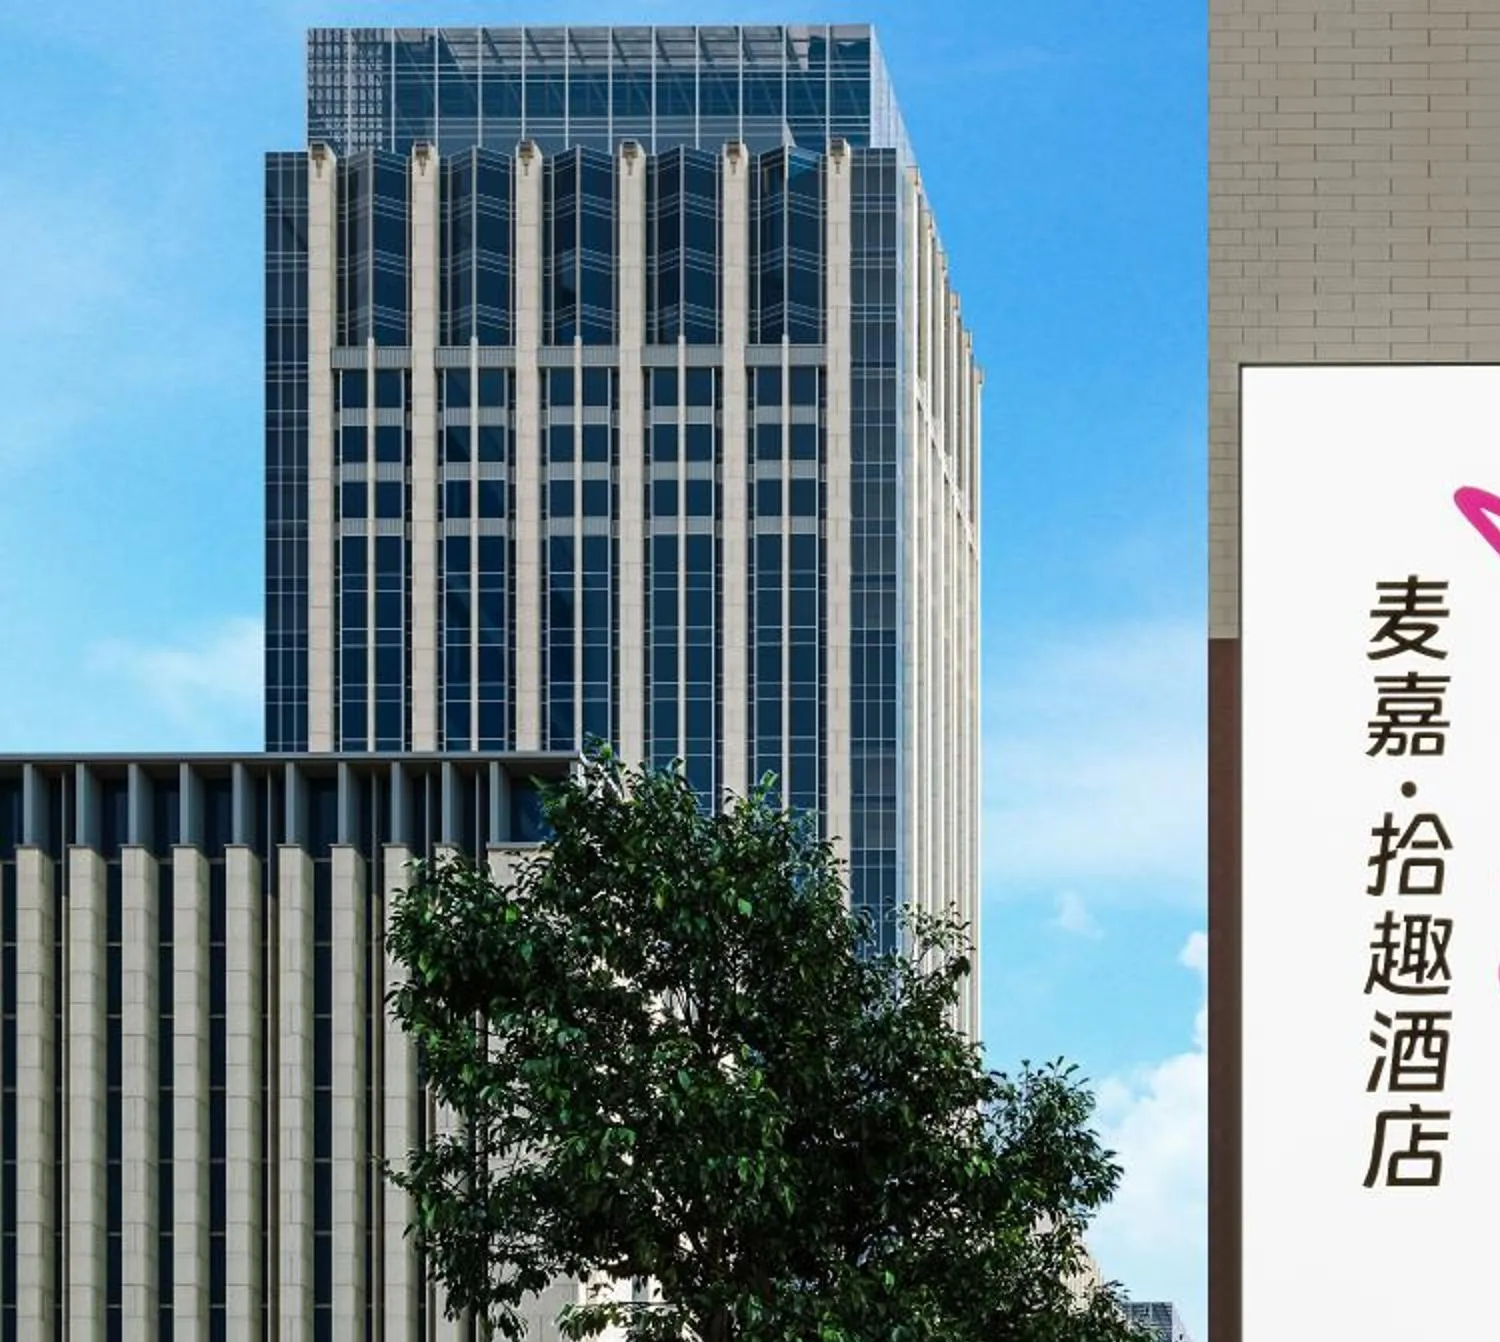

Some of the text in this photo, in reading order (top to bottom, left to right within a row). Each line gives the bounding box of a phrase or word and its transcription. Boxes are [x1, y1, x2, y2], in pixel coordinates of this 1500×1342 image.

[1363, 575, 1453, 1189] 麦嘉·拾趣酒店
